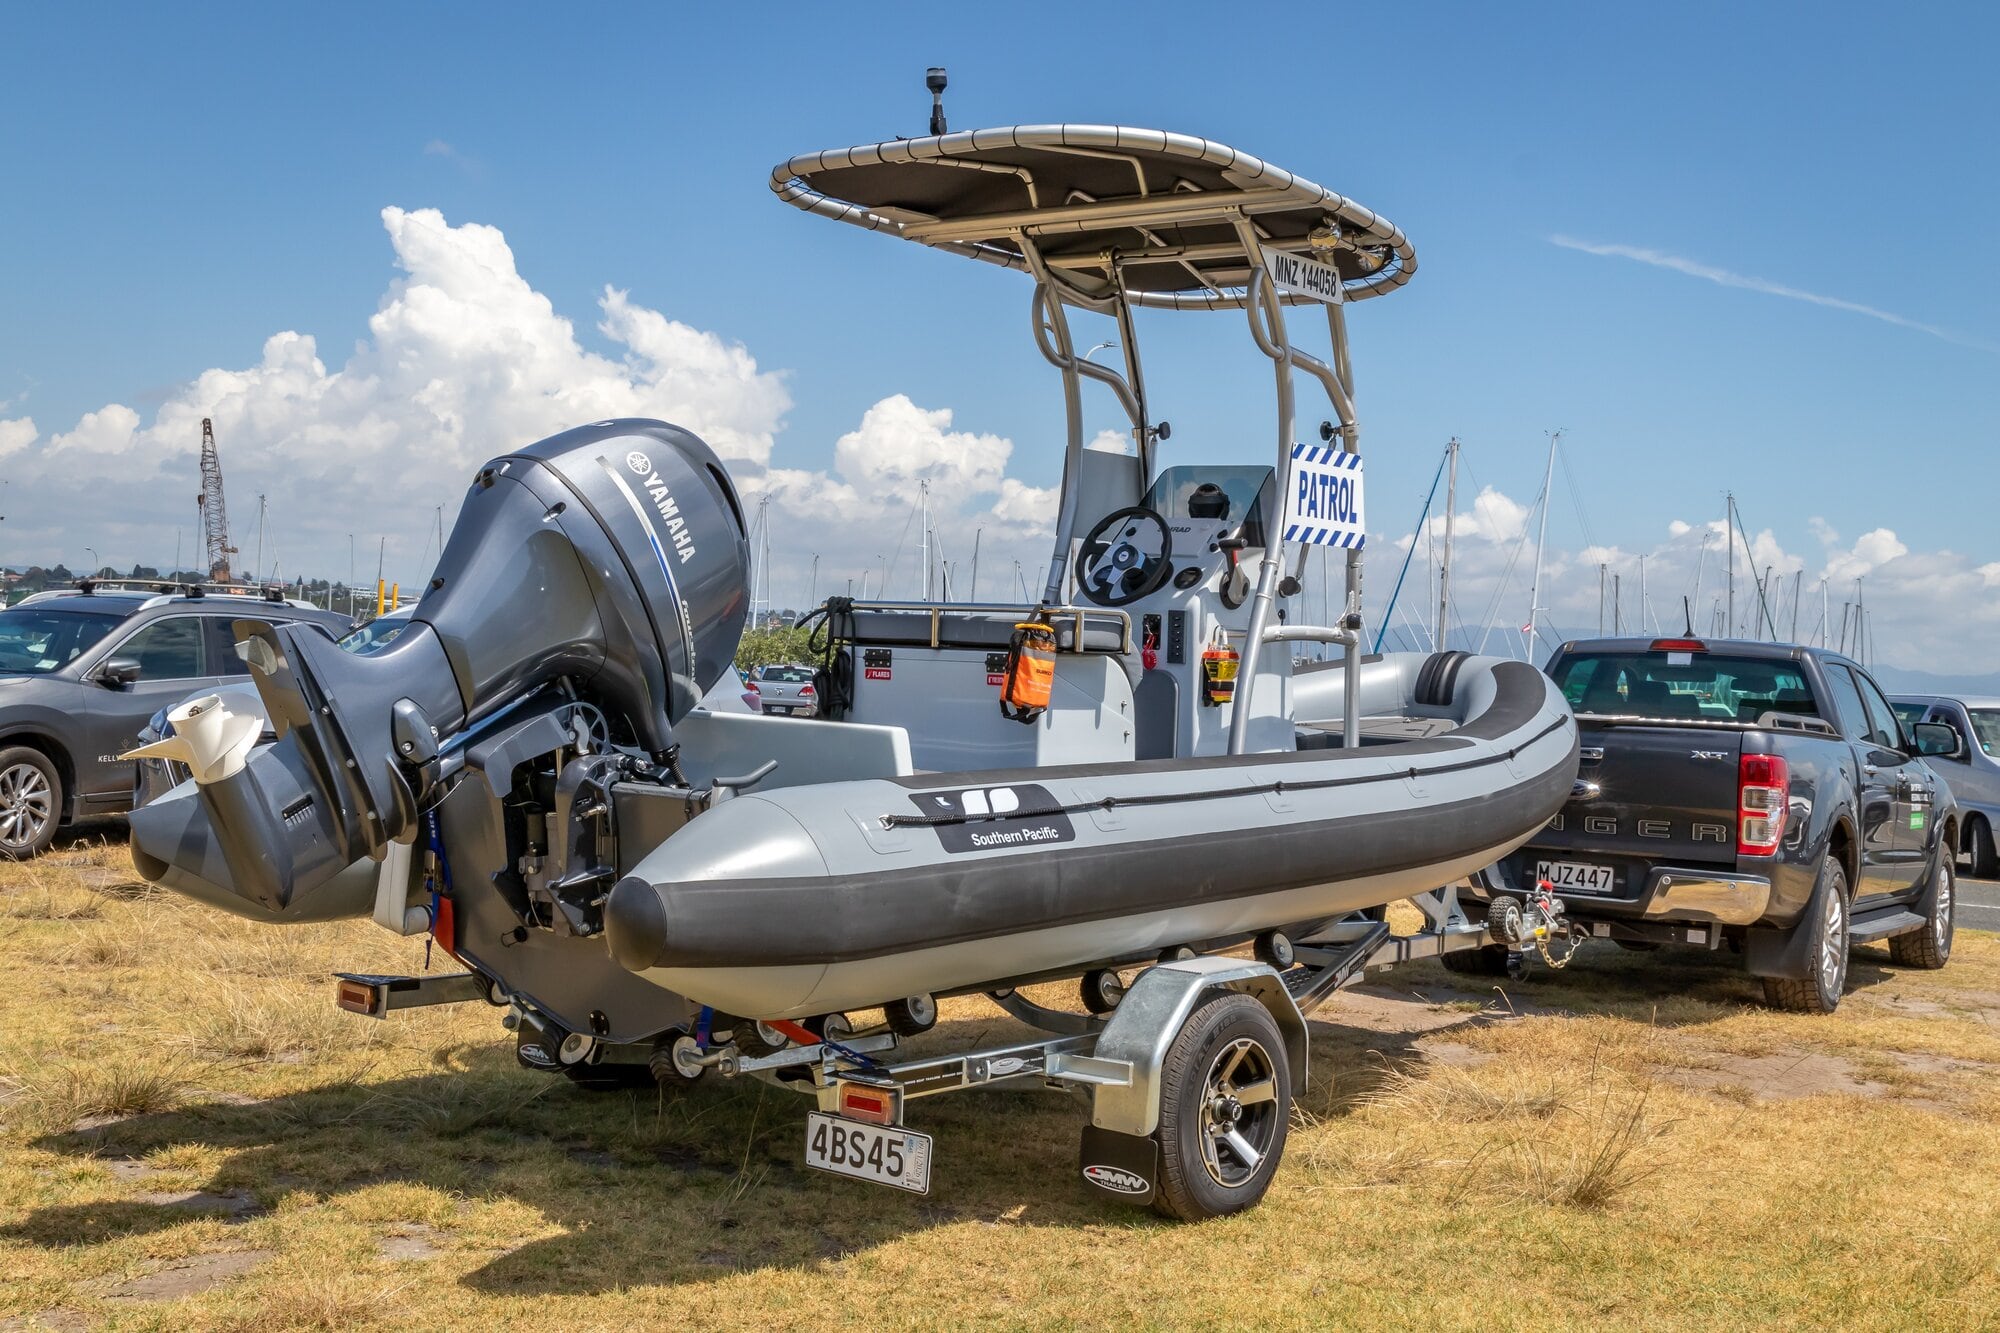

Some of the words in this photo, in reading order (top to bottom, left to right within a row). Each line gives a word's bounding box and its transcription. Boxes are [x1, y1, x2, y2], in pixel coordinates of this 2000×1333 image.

[1275, 255, 1298, 286] MNZ
[1302, 263, 1336, 297] 144058
[1298, 470, 1357, 524] PATROL
[643, 471, 696, 564] YAMAHA
[1691, 750, 1728, 760] XLT
[971, 831, 1022, 846] Southern
[1023, 826, 1059, 841] Pacific
[1539, 864, 1611, 889] MJZ447
[811, 1123, 904, 1177] 4BS45
[1101, 1180, 1132, 1192] TRAILERS
